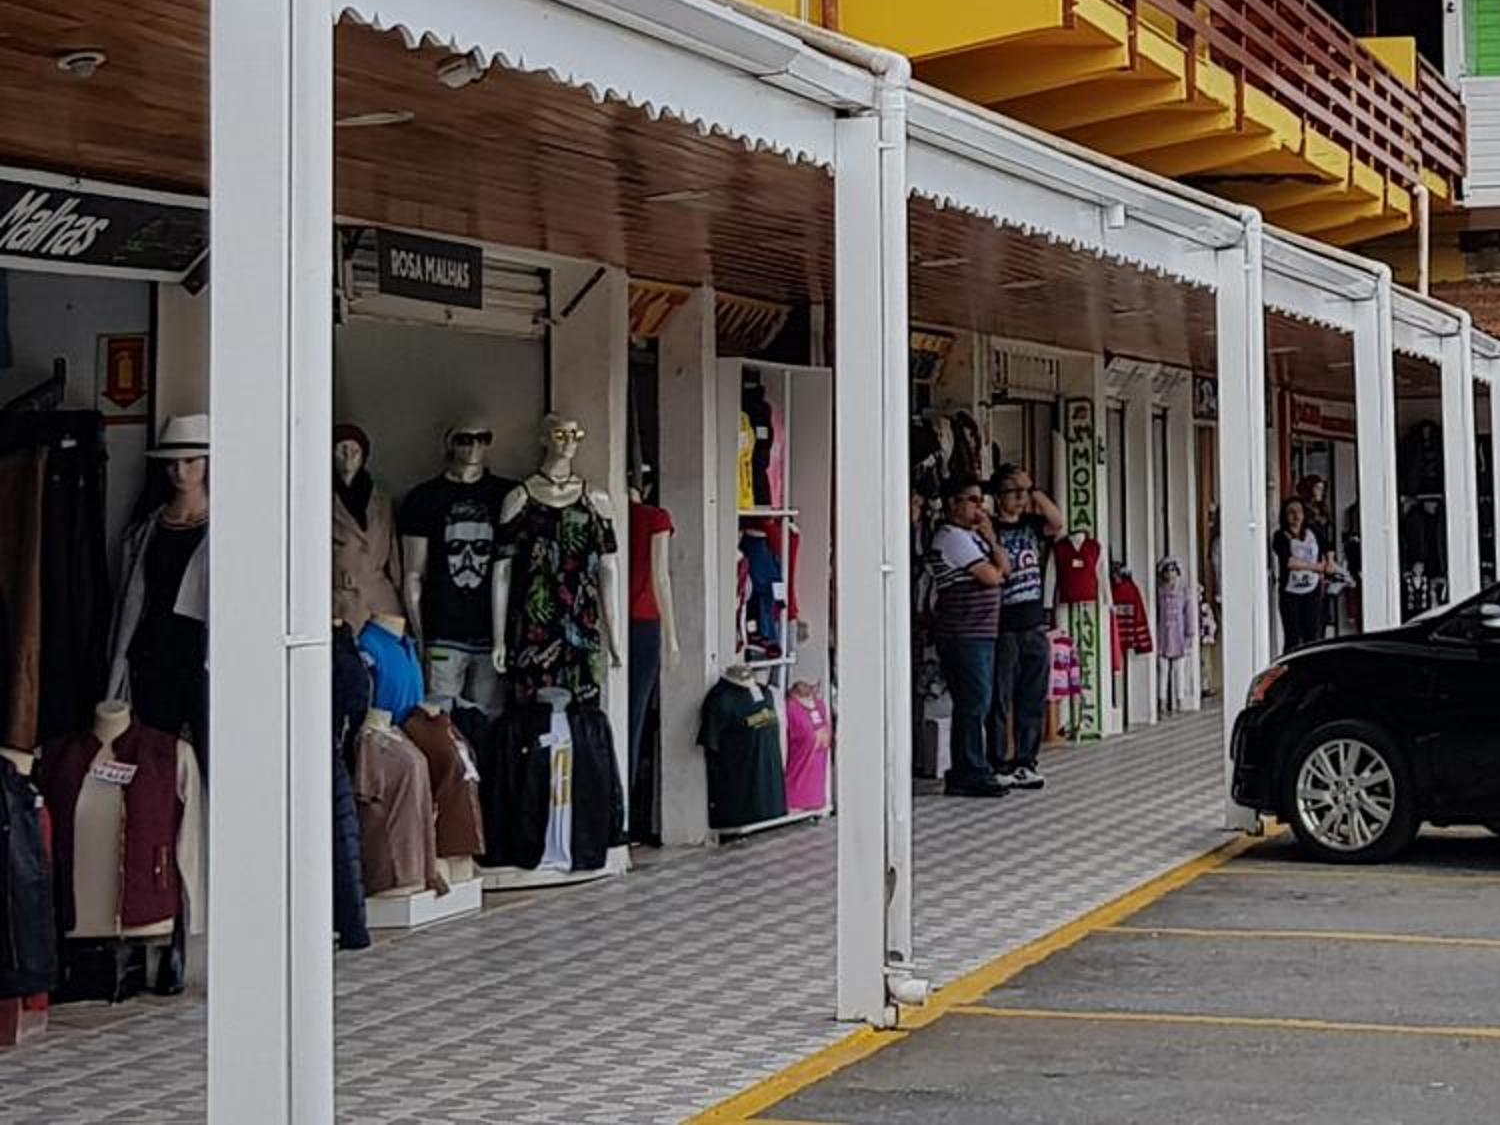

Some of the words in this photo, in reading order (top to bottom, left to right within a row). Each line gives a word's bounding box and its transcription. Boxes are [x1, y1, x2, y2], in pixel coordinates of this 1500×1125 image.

[0, 189, 110, 256] Malhas
[390, 248, 424, 281] ROSA
[425, 255, 470, 289] MALHAS
